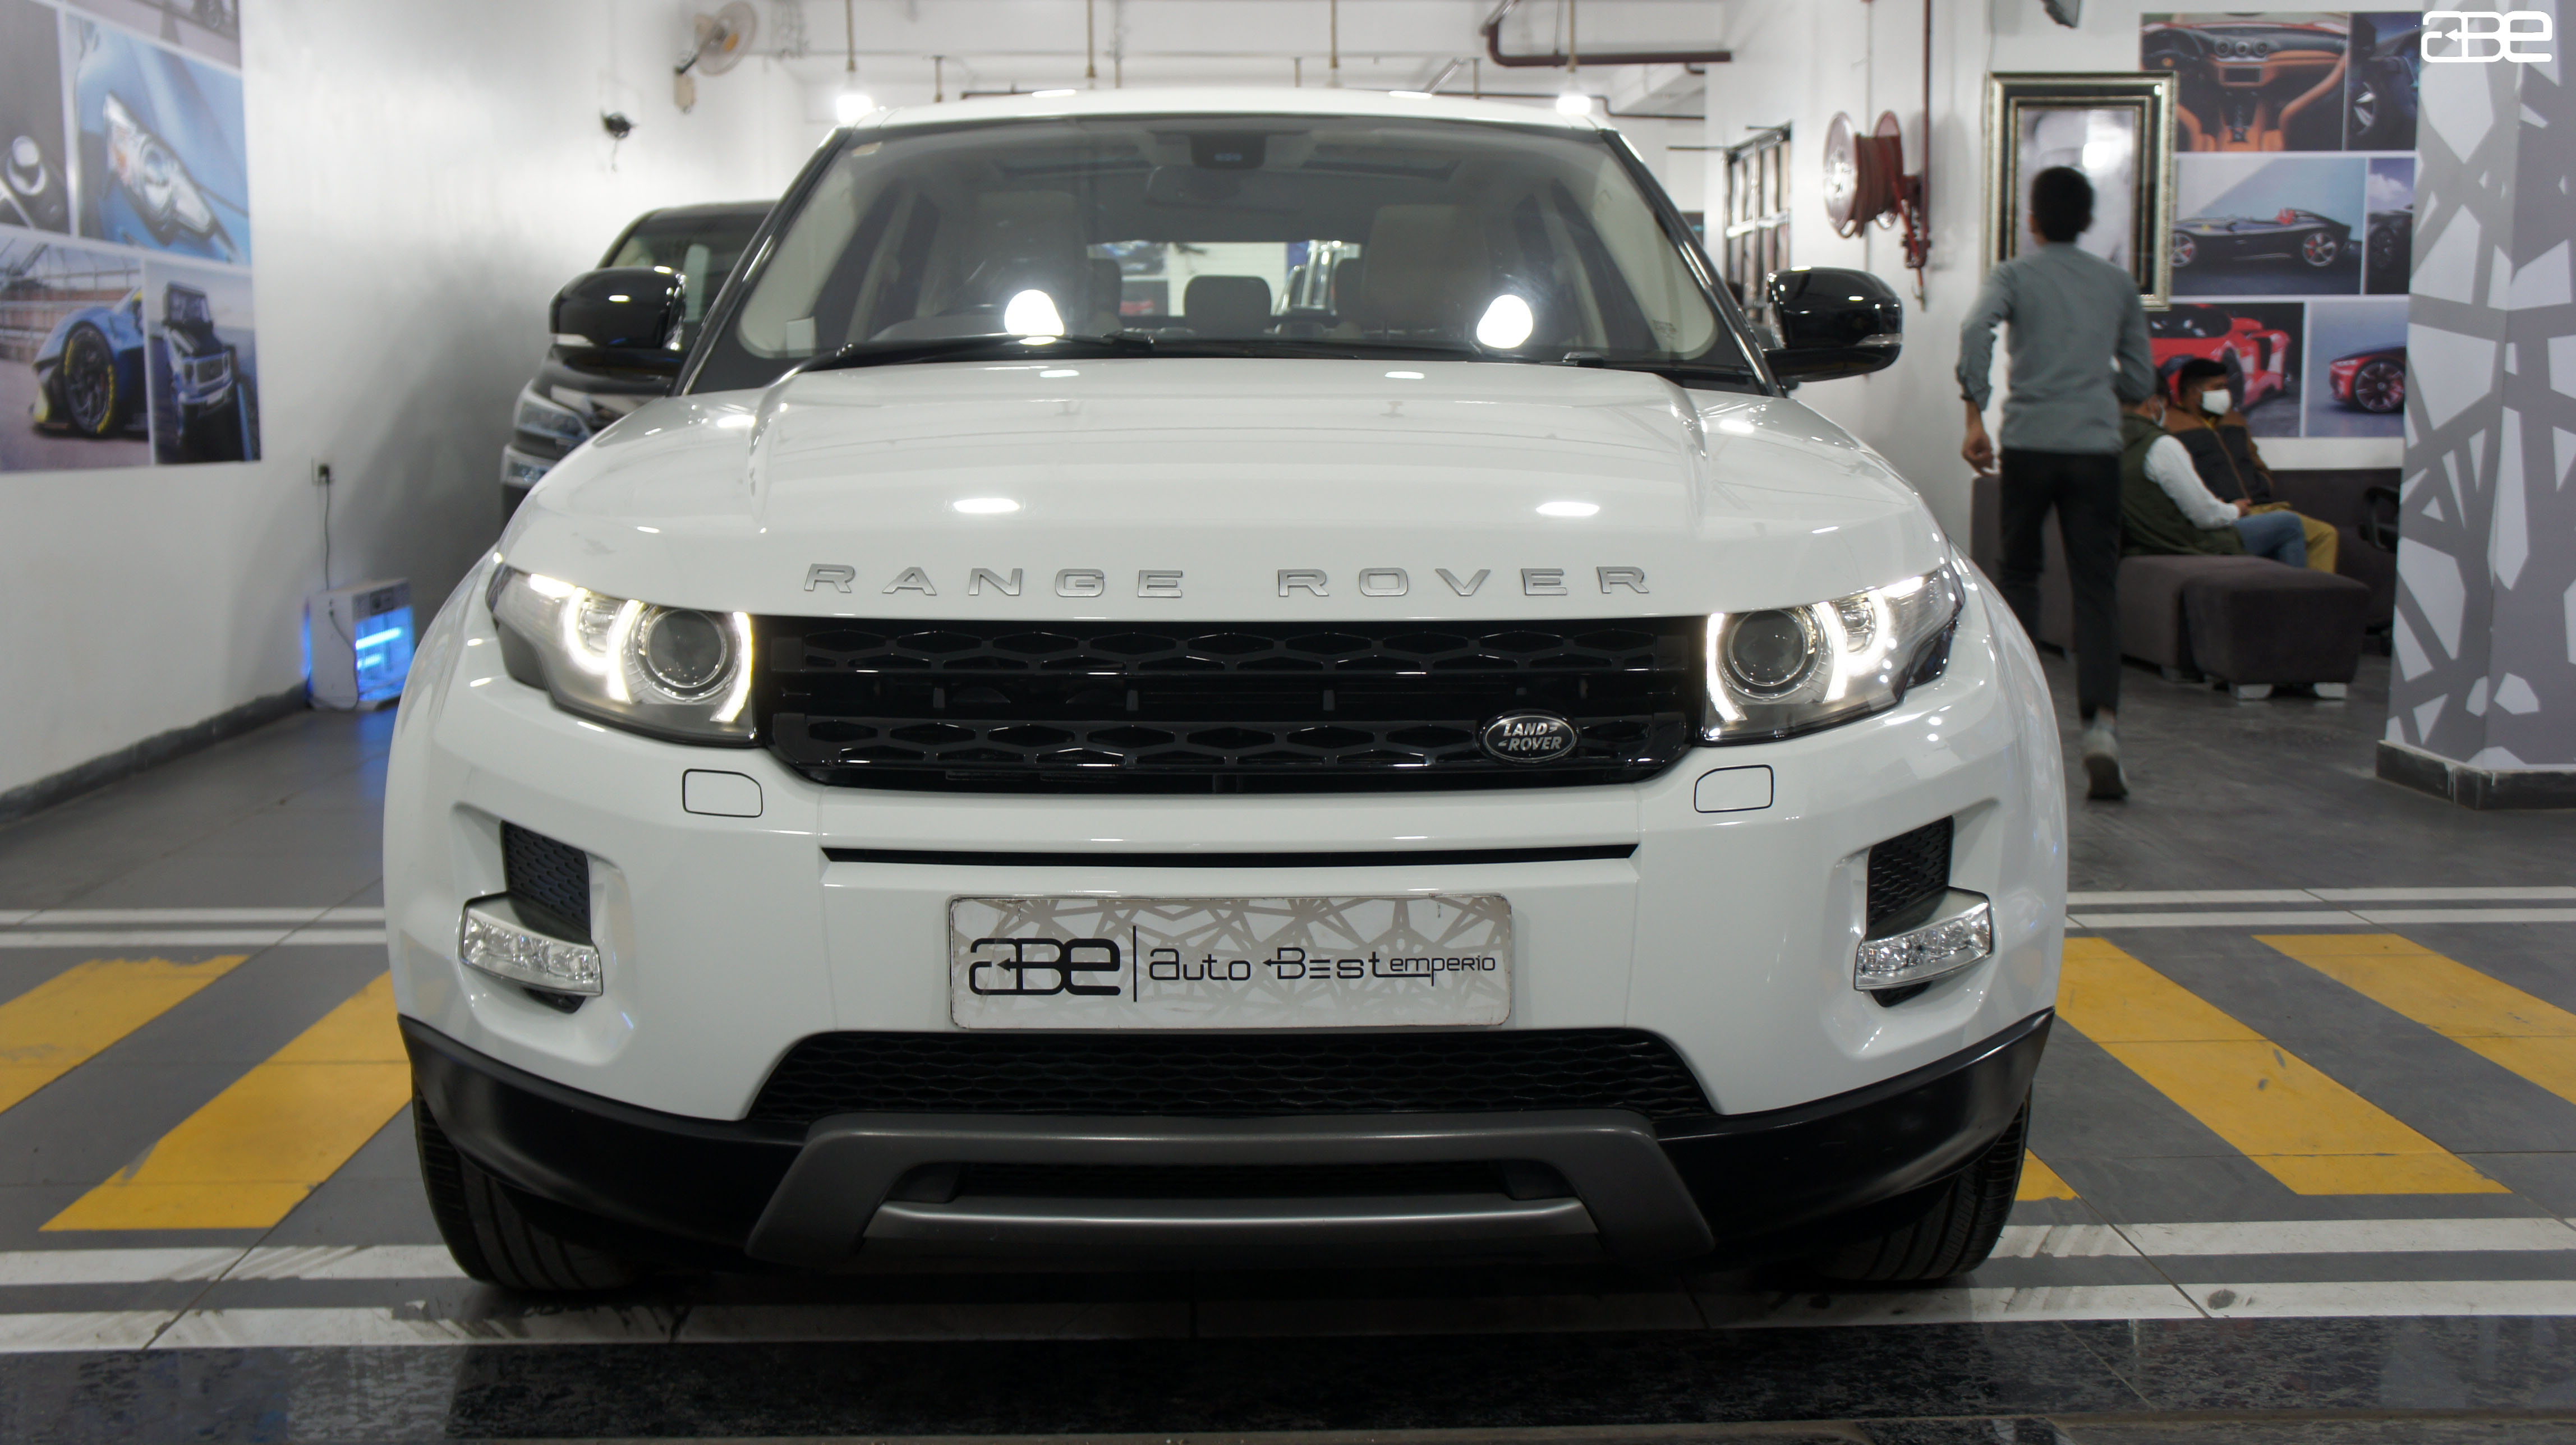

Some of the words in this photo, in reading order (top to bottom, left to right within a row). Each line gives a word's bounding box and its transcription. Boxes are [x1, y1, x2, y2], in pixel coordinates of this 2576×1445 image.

[803, 563, 1183, 598] RANGE
[1277, 566, 1650, 597] ROVER
[1503, 722, 1548, 737] LAND
[1507, 736, 1562, 751] ROVER
